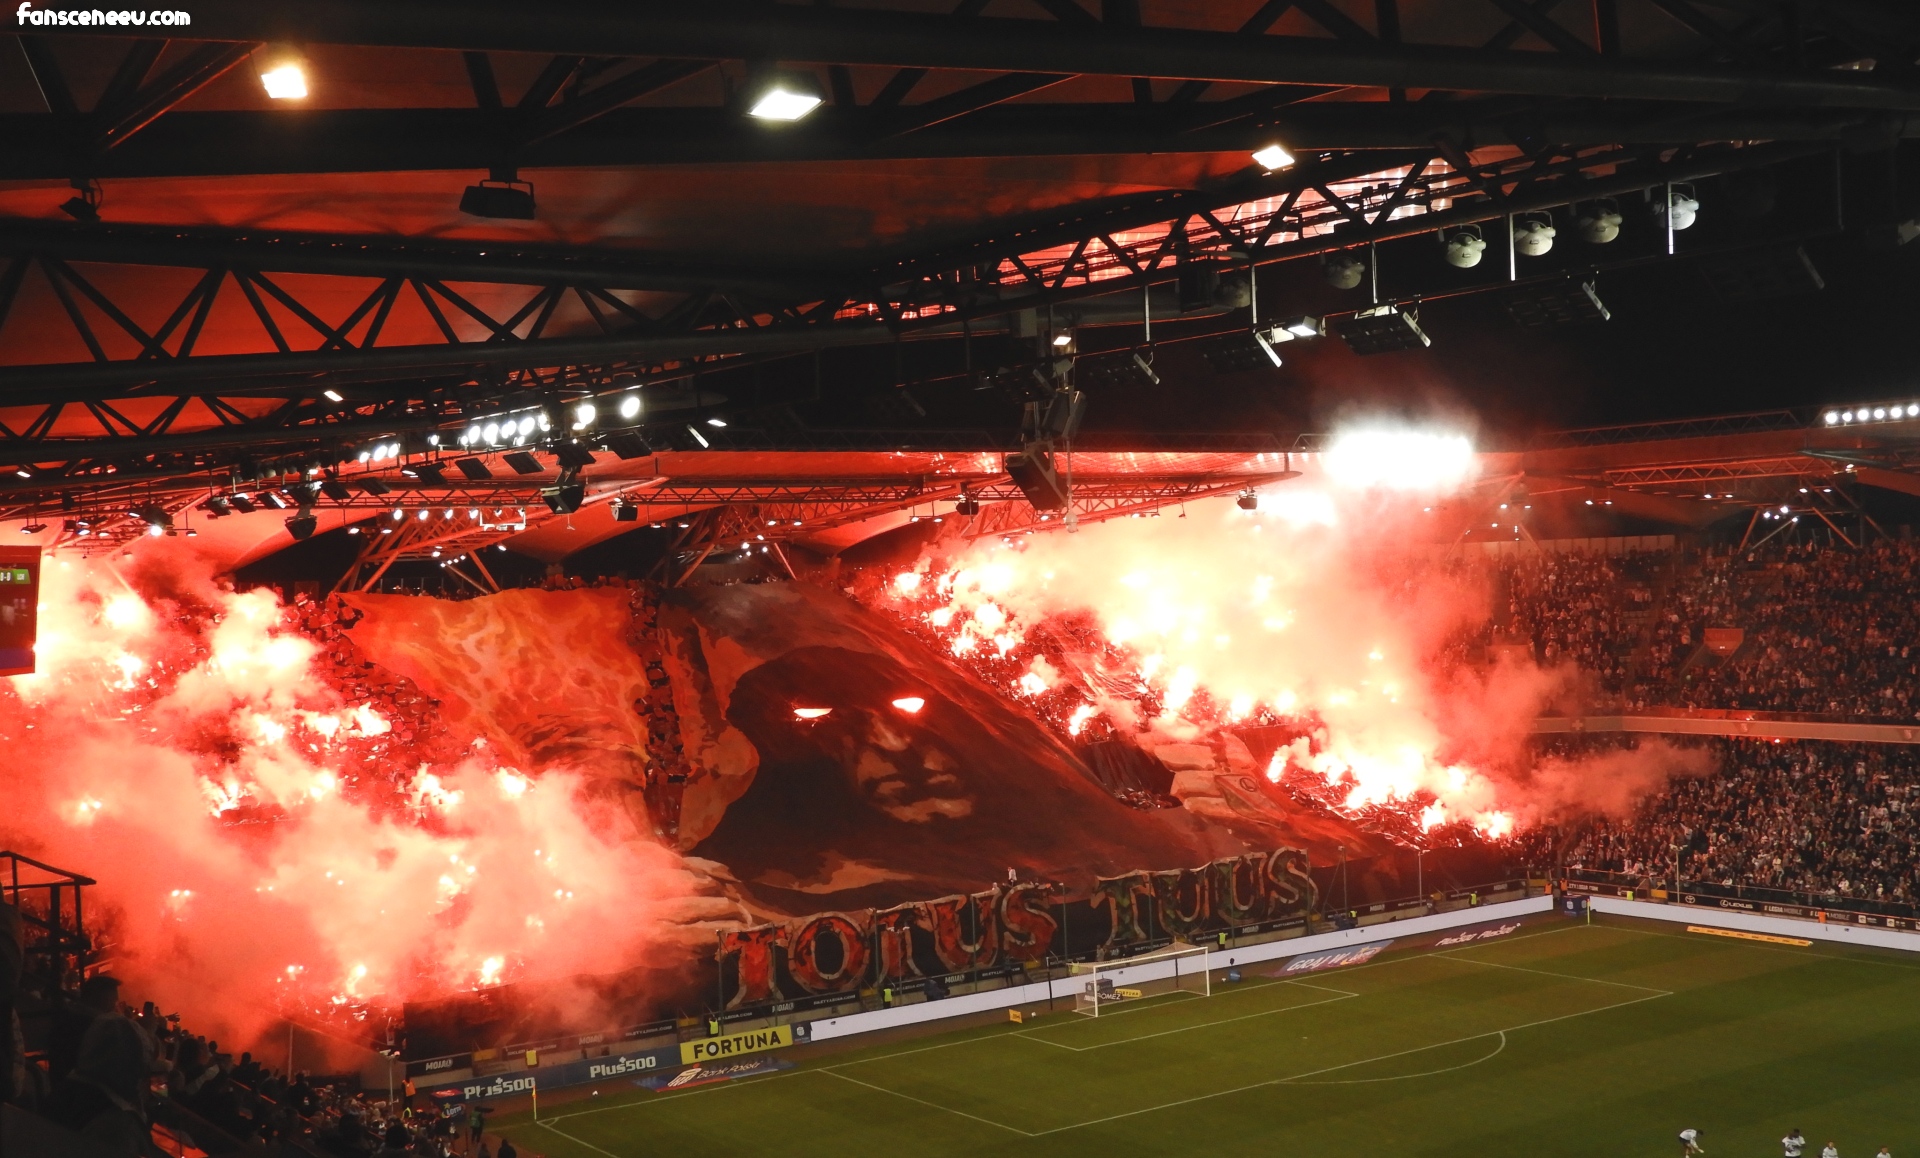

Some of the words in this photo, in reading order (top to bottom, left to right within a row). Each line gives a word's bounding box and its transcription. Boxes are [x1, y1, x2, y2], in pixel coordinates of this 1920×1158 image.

[714, 882, 1058, 1011] TOTUS
[693, 1030, 782, 1059] FORTUNA
[590, 1056, 657, 1078] Plus500
